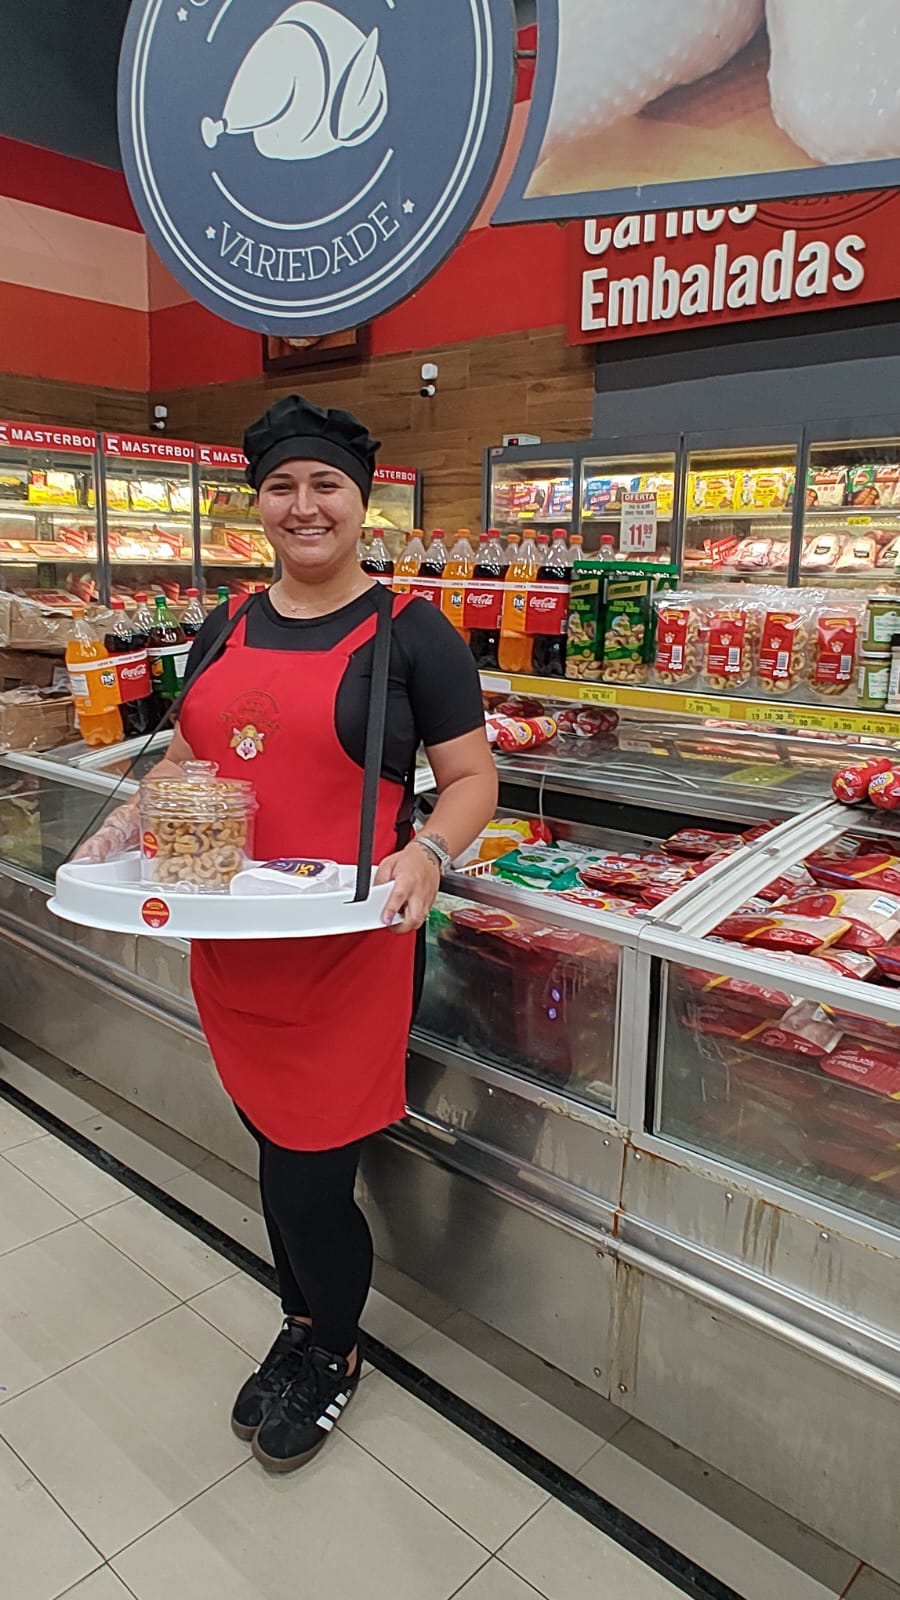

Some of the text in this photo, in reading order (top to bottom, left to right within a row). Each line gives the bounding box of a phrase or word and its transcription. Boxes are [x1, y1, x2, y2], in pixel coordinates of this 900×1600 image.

[219, 200, 401, 282] VARIEDADE
[580, 229, 866, 331] Embaladas
[11, 428, 96, 448] MASTERBOI
[121, 441, 194, 458] MASTERBOI
[373, 469, 416, 481] ASTERBOI
